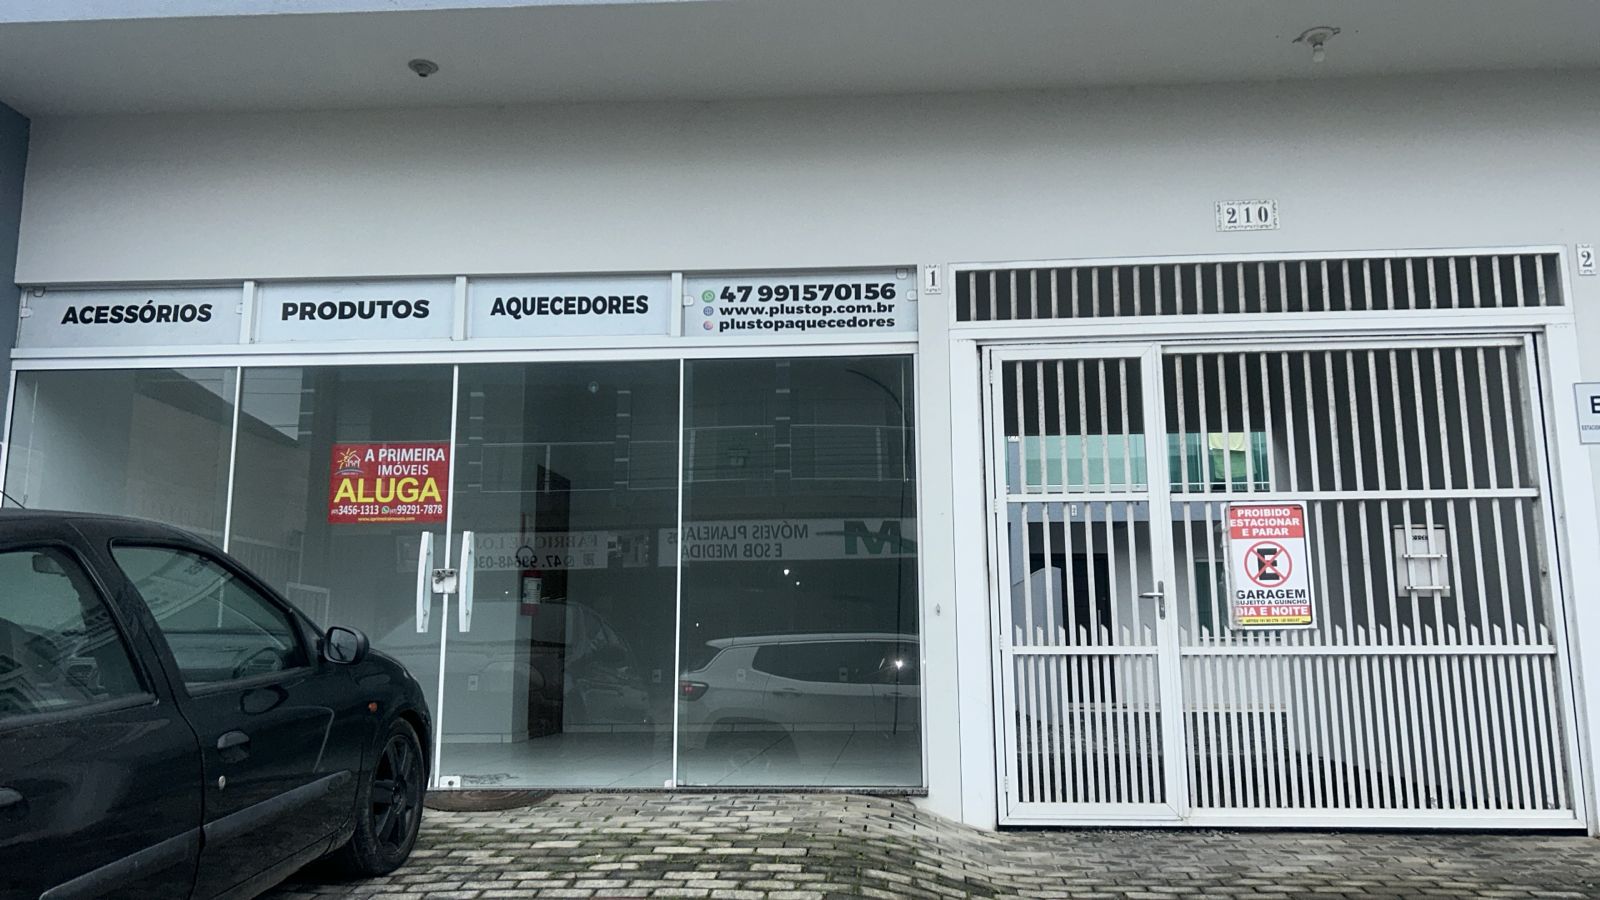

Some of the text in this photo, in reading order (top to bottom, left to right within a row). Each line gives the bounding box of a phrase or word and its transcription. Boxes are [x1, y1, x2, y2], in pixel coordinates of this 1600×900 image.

[1226, 206, 1269, 224] 210
[1581, 250, 1593, 267] 2
[719, 283, 896, 303] 47 991570156
[61, 299, 213, 325] ACESSÓRIOS
[281, 299, 430, 321] PRODUTOS
[490, 295, 649, 320] AQUECEDORES
[719, 302, 895, 317] www.plustop.com.br
[719, 316, 896, 332] plustopaquecedores
[365, 448, 445, 462] A PRIMEIRA
[378, 462, 429, 476] IMÓVEIS
[333, 477, 442, 503] ALUGA
[1237, 508, 1290, 518] PROIBIDO
[1230, 518, 1300, 527] ESTACIONAR
[1242, 527, 1289, 536] E PARAR
[1236, 588, 1306, 599] GARAGEM
[1236, 606, 1309, 616] DIA E NOITE
